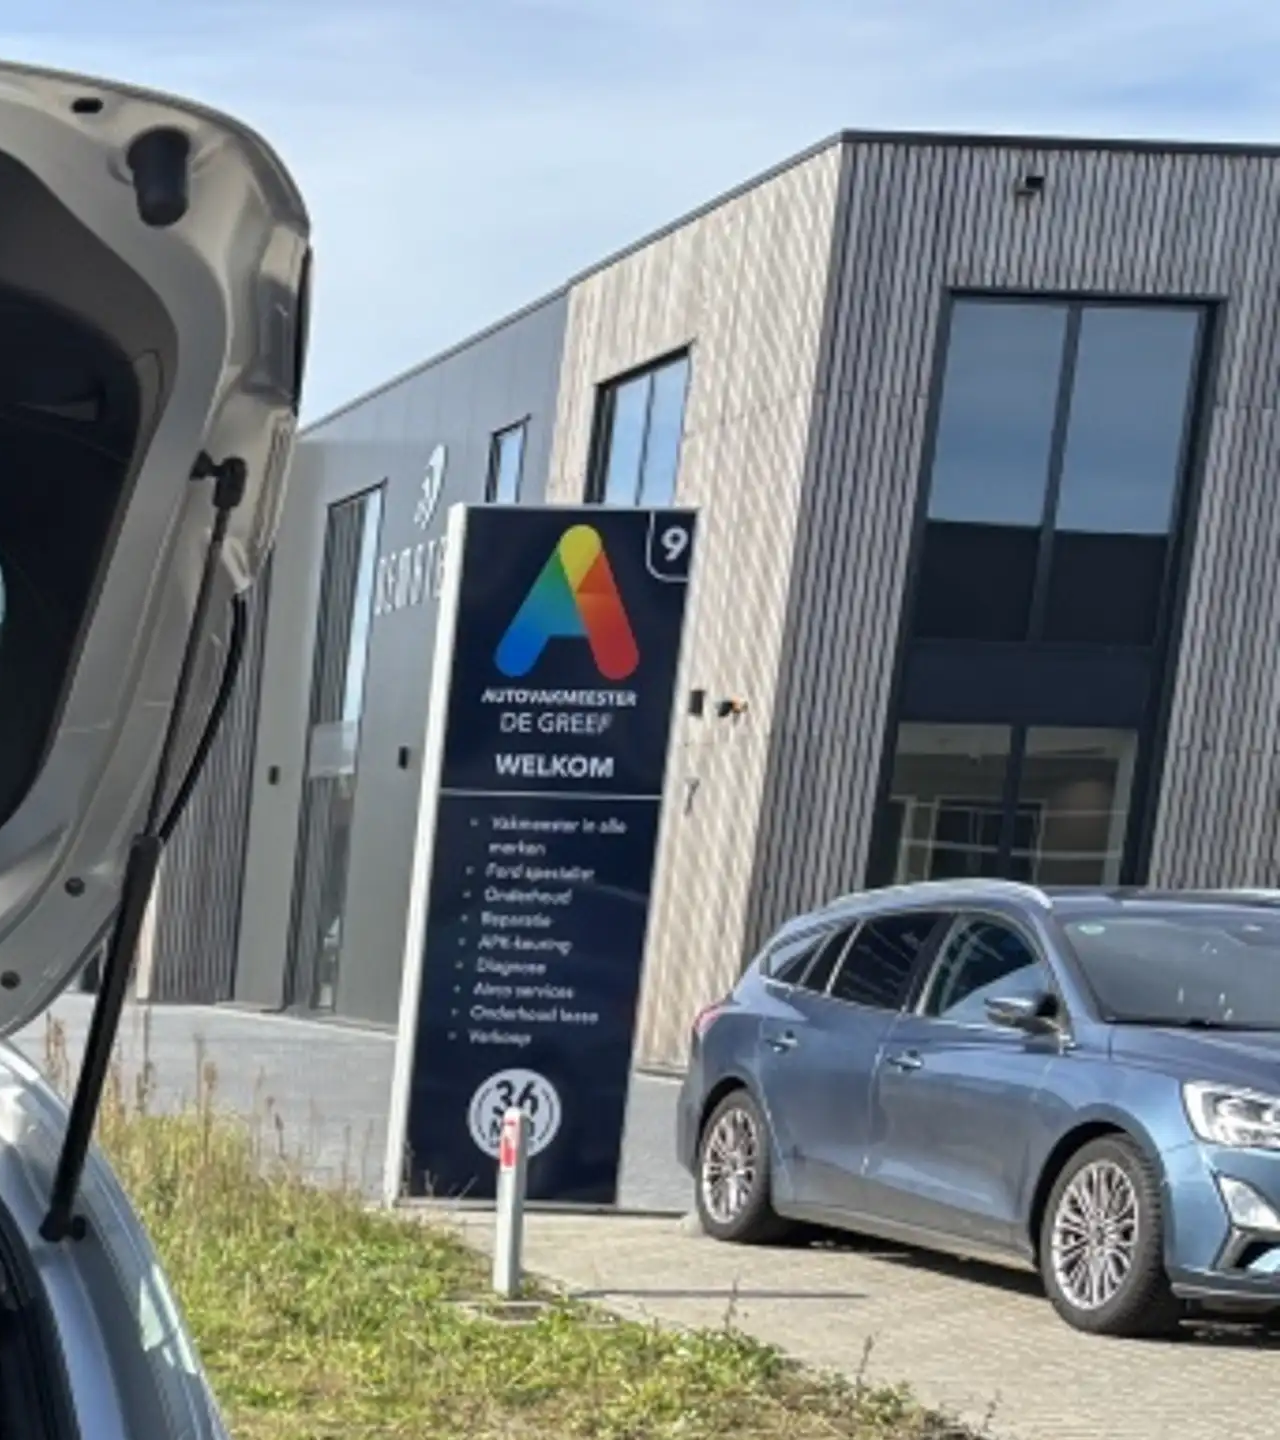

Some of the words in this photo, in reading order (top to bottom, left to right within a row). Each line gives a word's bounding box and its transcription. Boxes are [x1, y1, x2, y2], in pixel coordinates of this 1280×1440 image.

[661, 526, 688, 561] 9
[481, 688, 638, 707] AUTOVAKMEESTER
[499, 712, 533, 733] DE
[537, 712, 614, 735] GREEF
[495, 753, 615, 778] WELKOM
